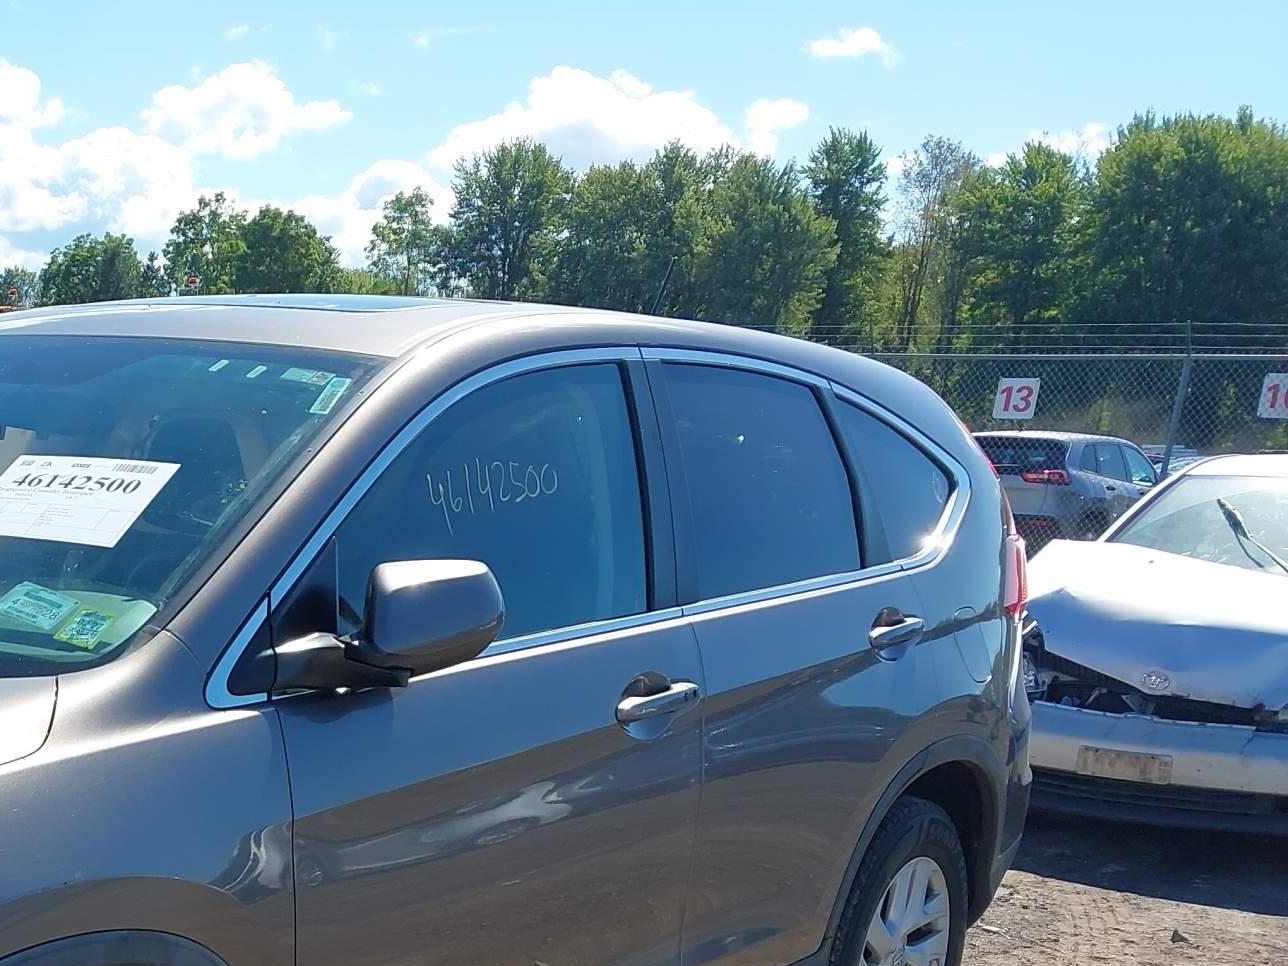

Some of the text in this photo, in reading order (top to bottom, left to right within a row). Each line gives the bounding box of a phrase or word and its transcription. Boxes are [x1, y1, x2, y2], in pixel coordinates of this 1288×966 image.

[999, 384, 1035, 413] 13
[12, 472, 142, 495] 46142500
[426, 455, 559, 537] 46142500
